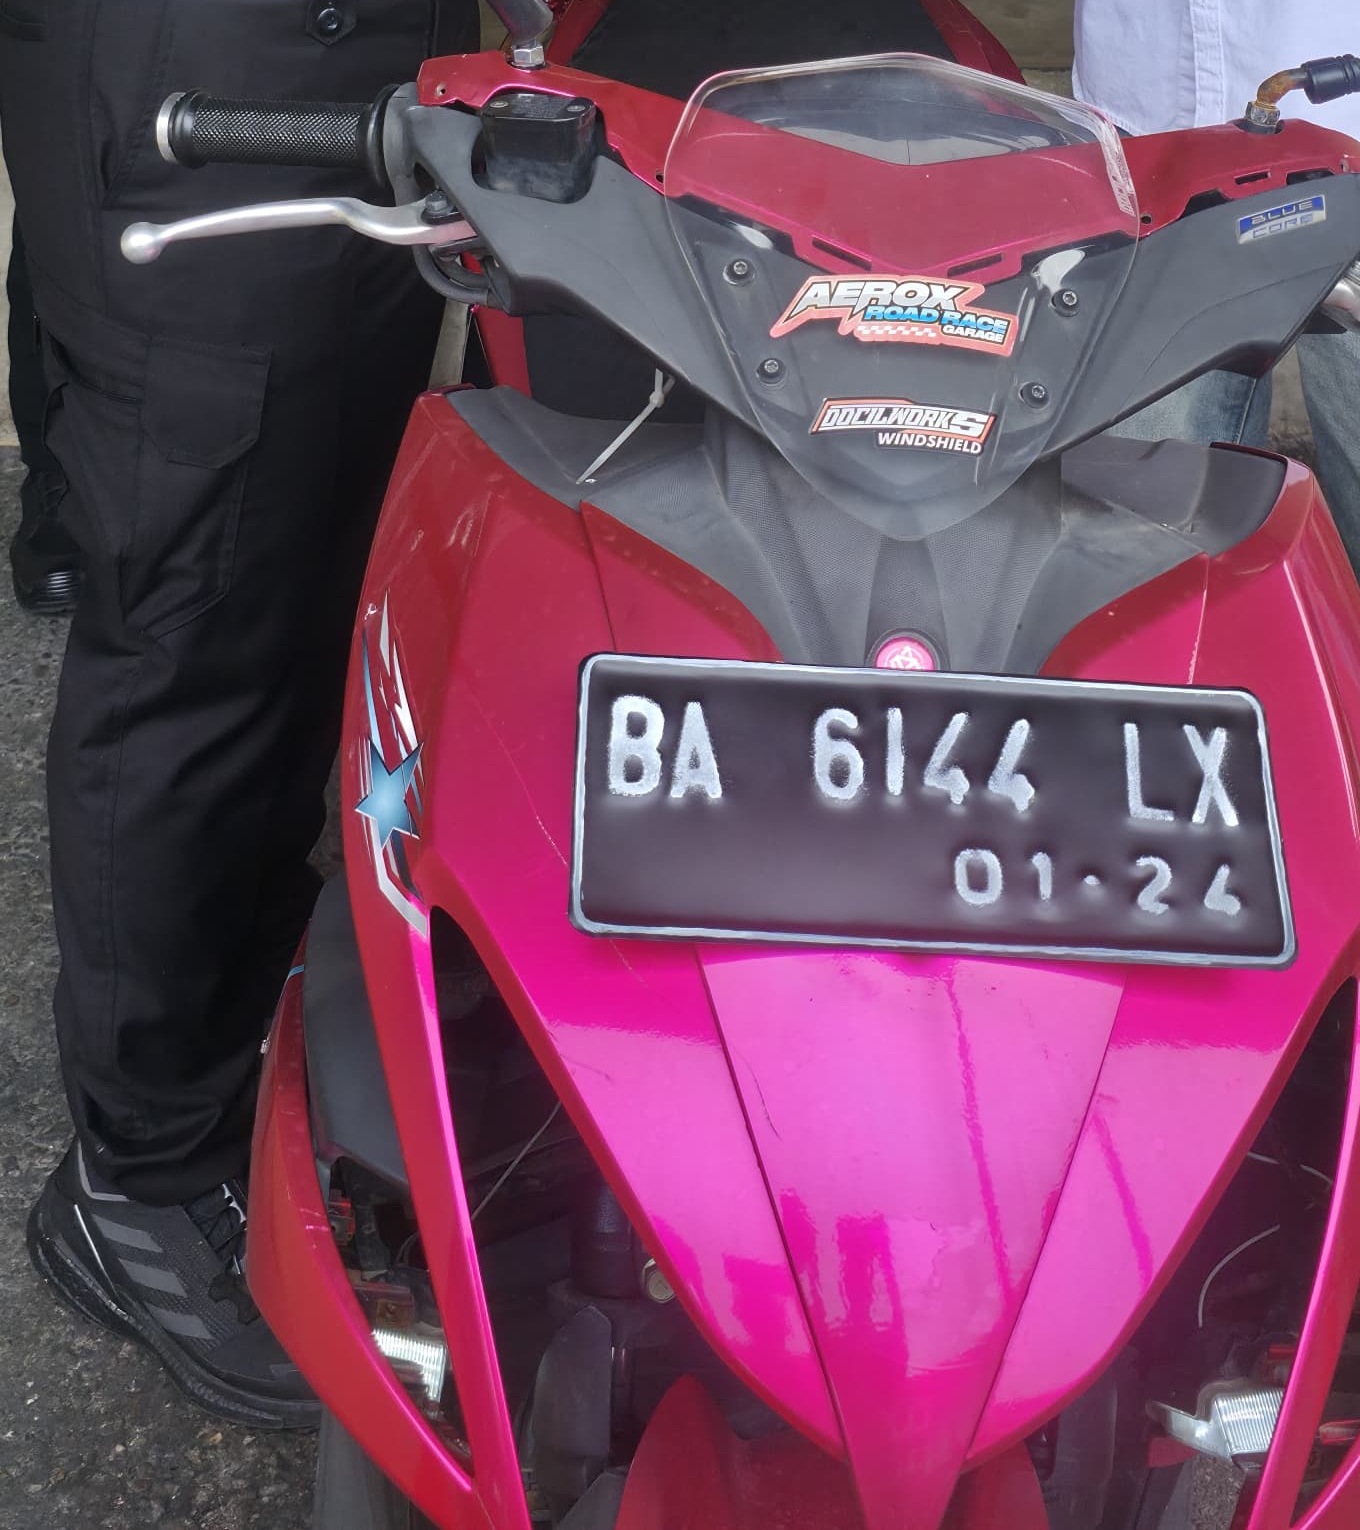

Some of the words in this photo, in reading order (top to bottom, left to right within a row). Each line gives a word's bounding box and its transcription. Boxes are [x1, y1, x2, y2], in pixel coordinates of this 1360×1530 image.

[1251, 200, 1313, 225] BLUE
[1252, 214, 1313, 239] CORE
[784, 280, 969, 325] AEROX
[863, 305, 940, 322] ROAD
[940, 309, 1010, 334] RACE
[942, 324, 1005, 344] GARAGE
[822, 406, 991, 438] DOCILWORKS
[877, 432, 983, 455] WINDSHIELD
[608, 694, 723, 799] BA
[812, 706, 1036, 813] 6144
[1123, 722, 1240, 828] LX
